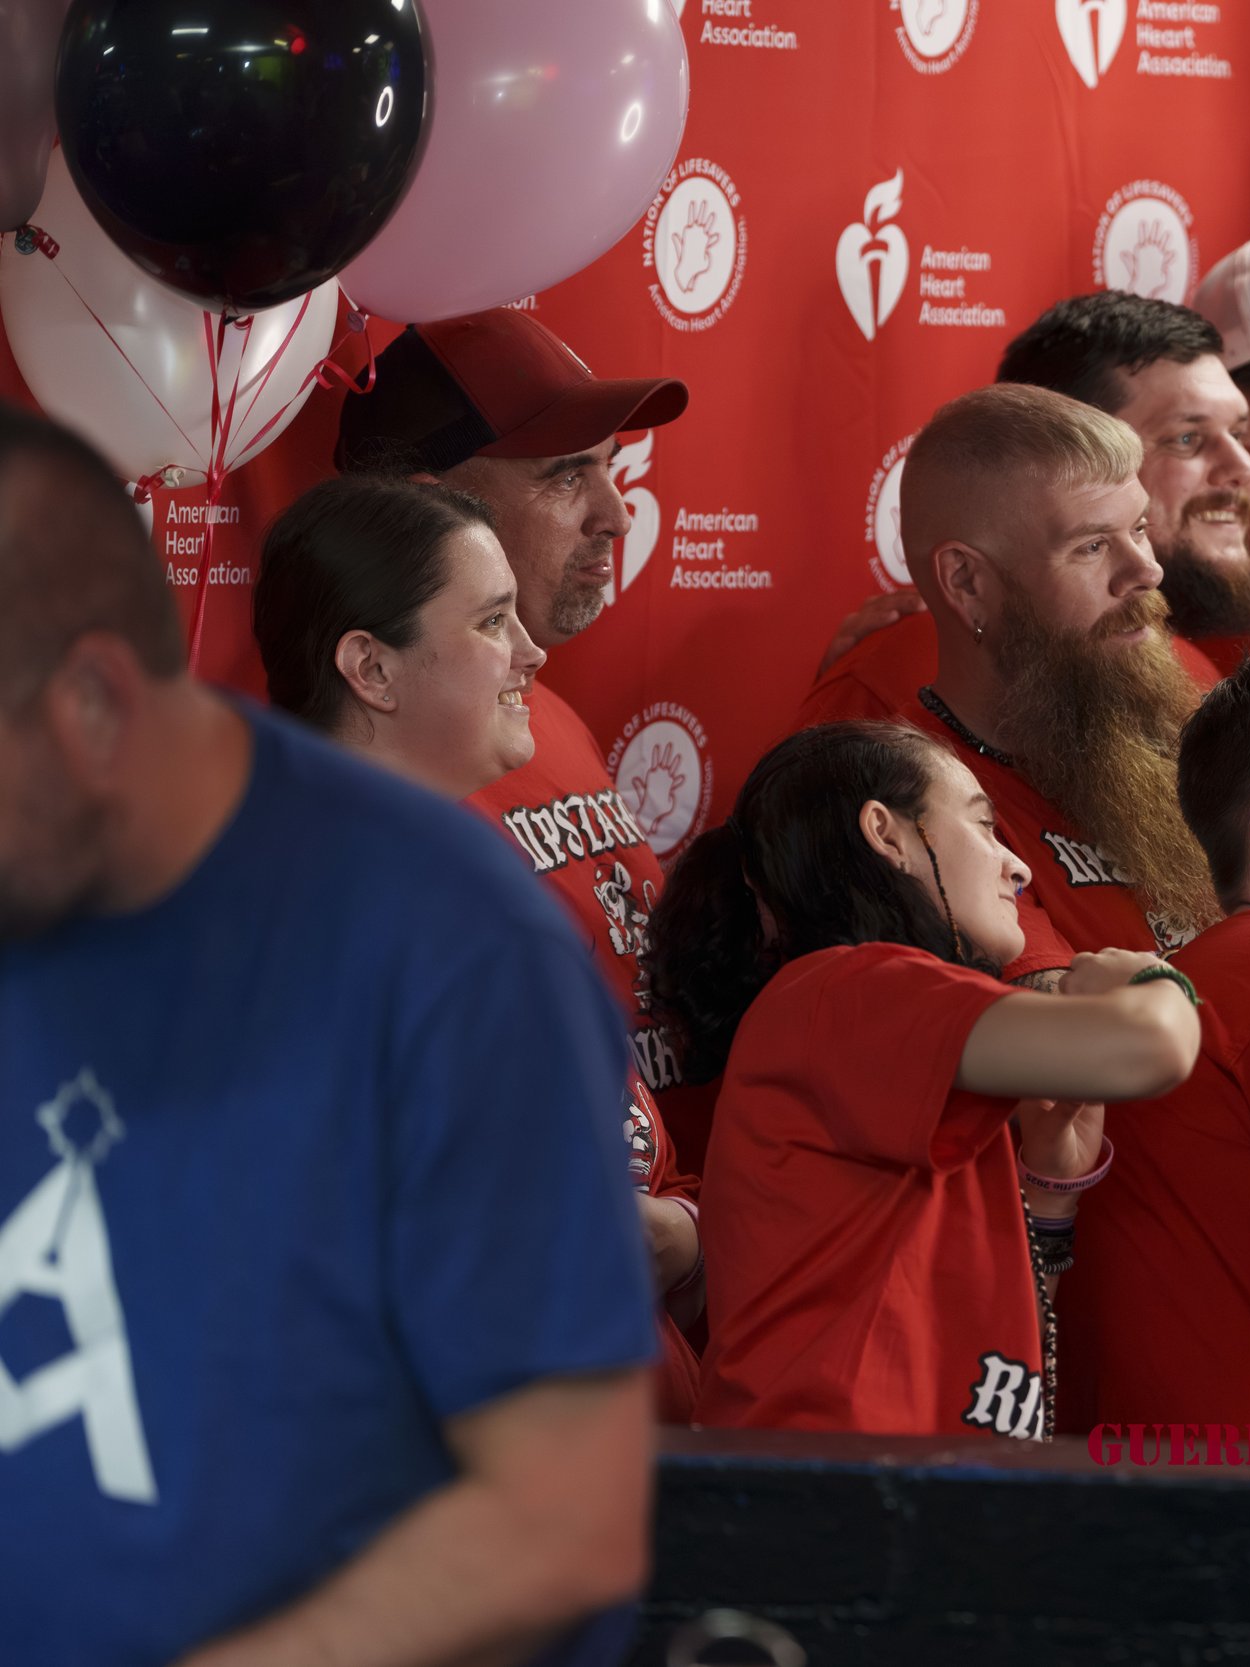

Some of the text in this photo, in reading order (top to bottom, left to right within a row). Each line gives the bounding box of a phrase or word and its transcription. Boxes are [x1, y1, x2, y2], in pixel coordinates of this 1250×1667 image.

[700, 20, 798, 49] Association
[1136, 23, 1196, 49] Heart
[1136, 50, 1232, 78] Association
[643, 158, 741, 267] NATION OF LIFESAVERS
[920, 244, 992, 271] American
[920, 272, 966, 298] Heart
[919, 300, 1006, 327] Association
[674, 507, 759, 532] American
[672, 536, 724, 560] Heart
[166, 560, 251, 586] Assoation
[670, 564, 771, 589] Association
[623, 712, 641, 738] OF
[643, 701, 708, 749] LIFESAVERS
